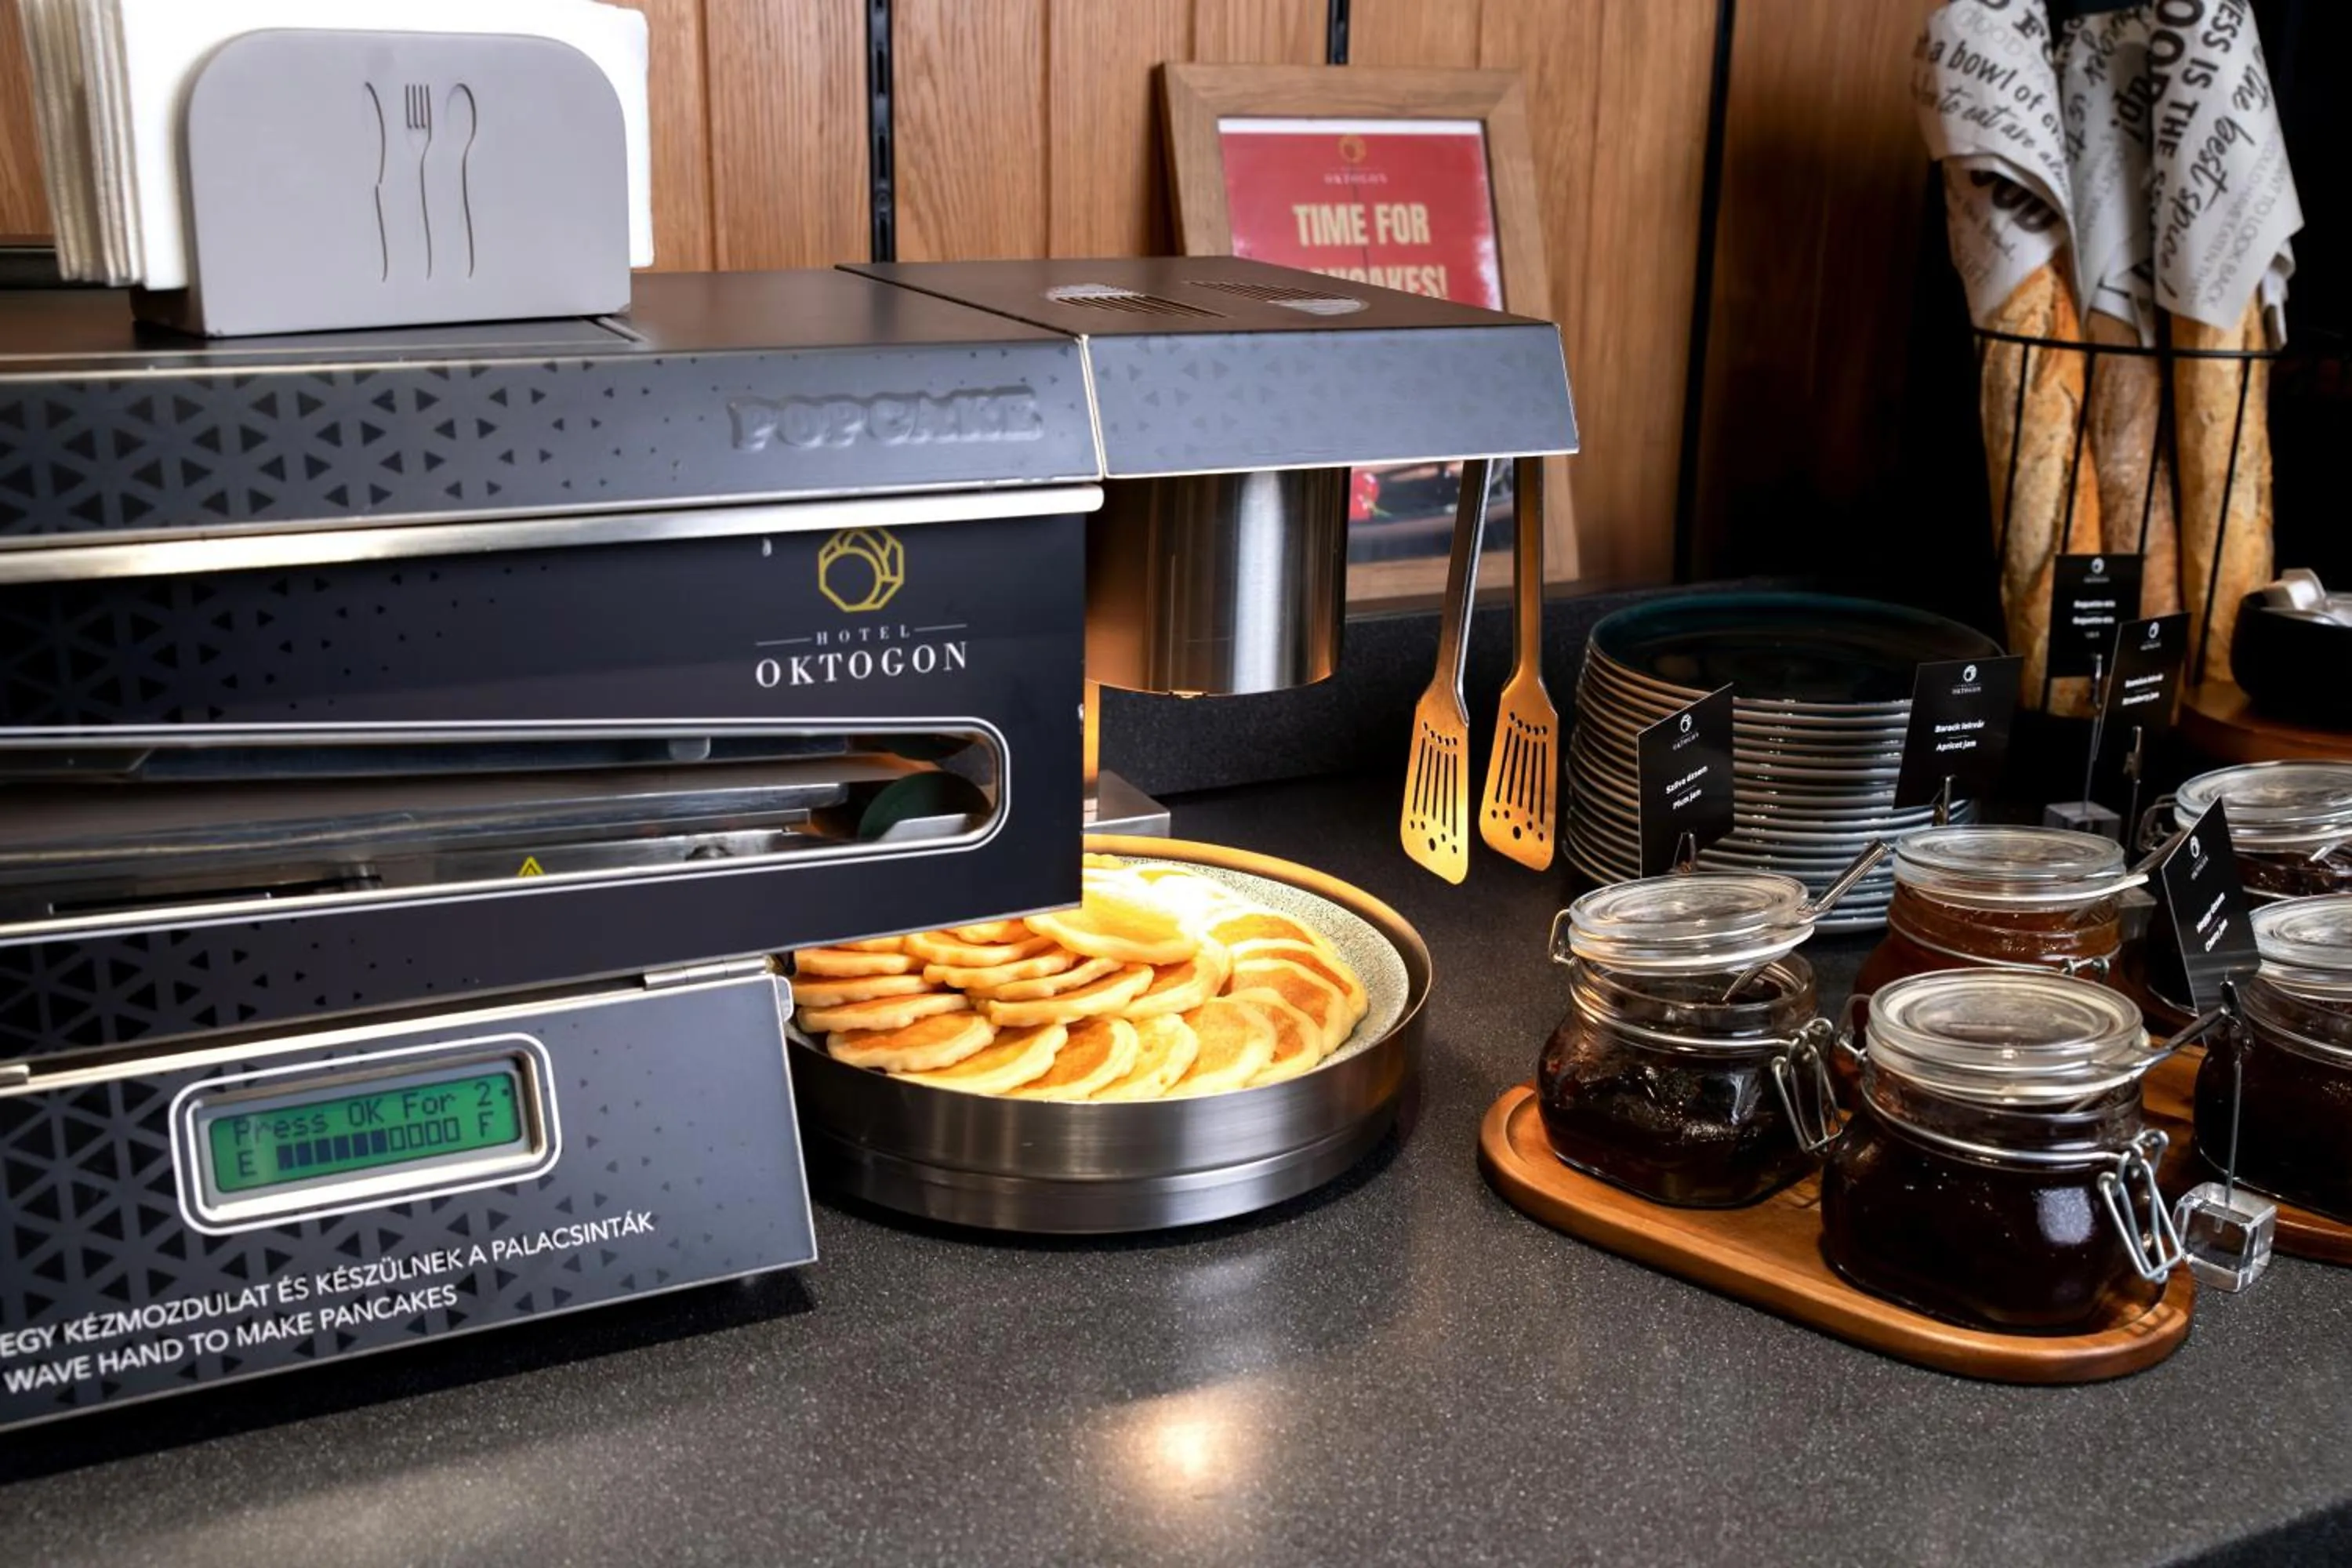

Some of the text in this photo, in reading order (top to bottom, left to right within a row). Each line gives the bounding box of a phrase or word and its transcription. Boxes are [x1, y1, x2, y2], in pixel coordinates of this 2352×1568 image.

[1947, 41, 2018, 91] bowl
[2014, 85, 2045, 111] of
[2181, 57, 2220, 89] IS
[2157, 100, 2200, 159] THE
[2190, 115, 2256, 212] best
[1292, 202, 1431, 248] TIME FOR
[1308, 264, 1449, 301] AKES!
[755, 641, 967, 688] OKTOGON
[815, 624, 910, 646] HOTEL
[233, 1082, 493, 1146] Press OK For 2
[238, 1110, 495, 1176] E F
[0, 1210, 655, 1359] EGY KÉZMOZDULAT ÉS KÉSZÜLNEK A PALACSINTÁK
[3, 1283, 459, 1394] WAVE HAND TO MAKE PANCAKES
